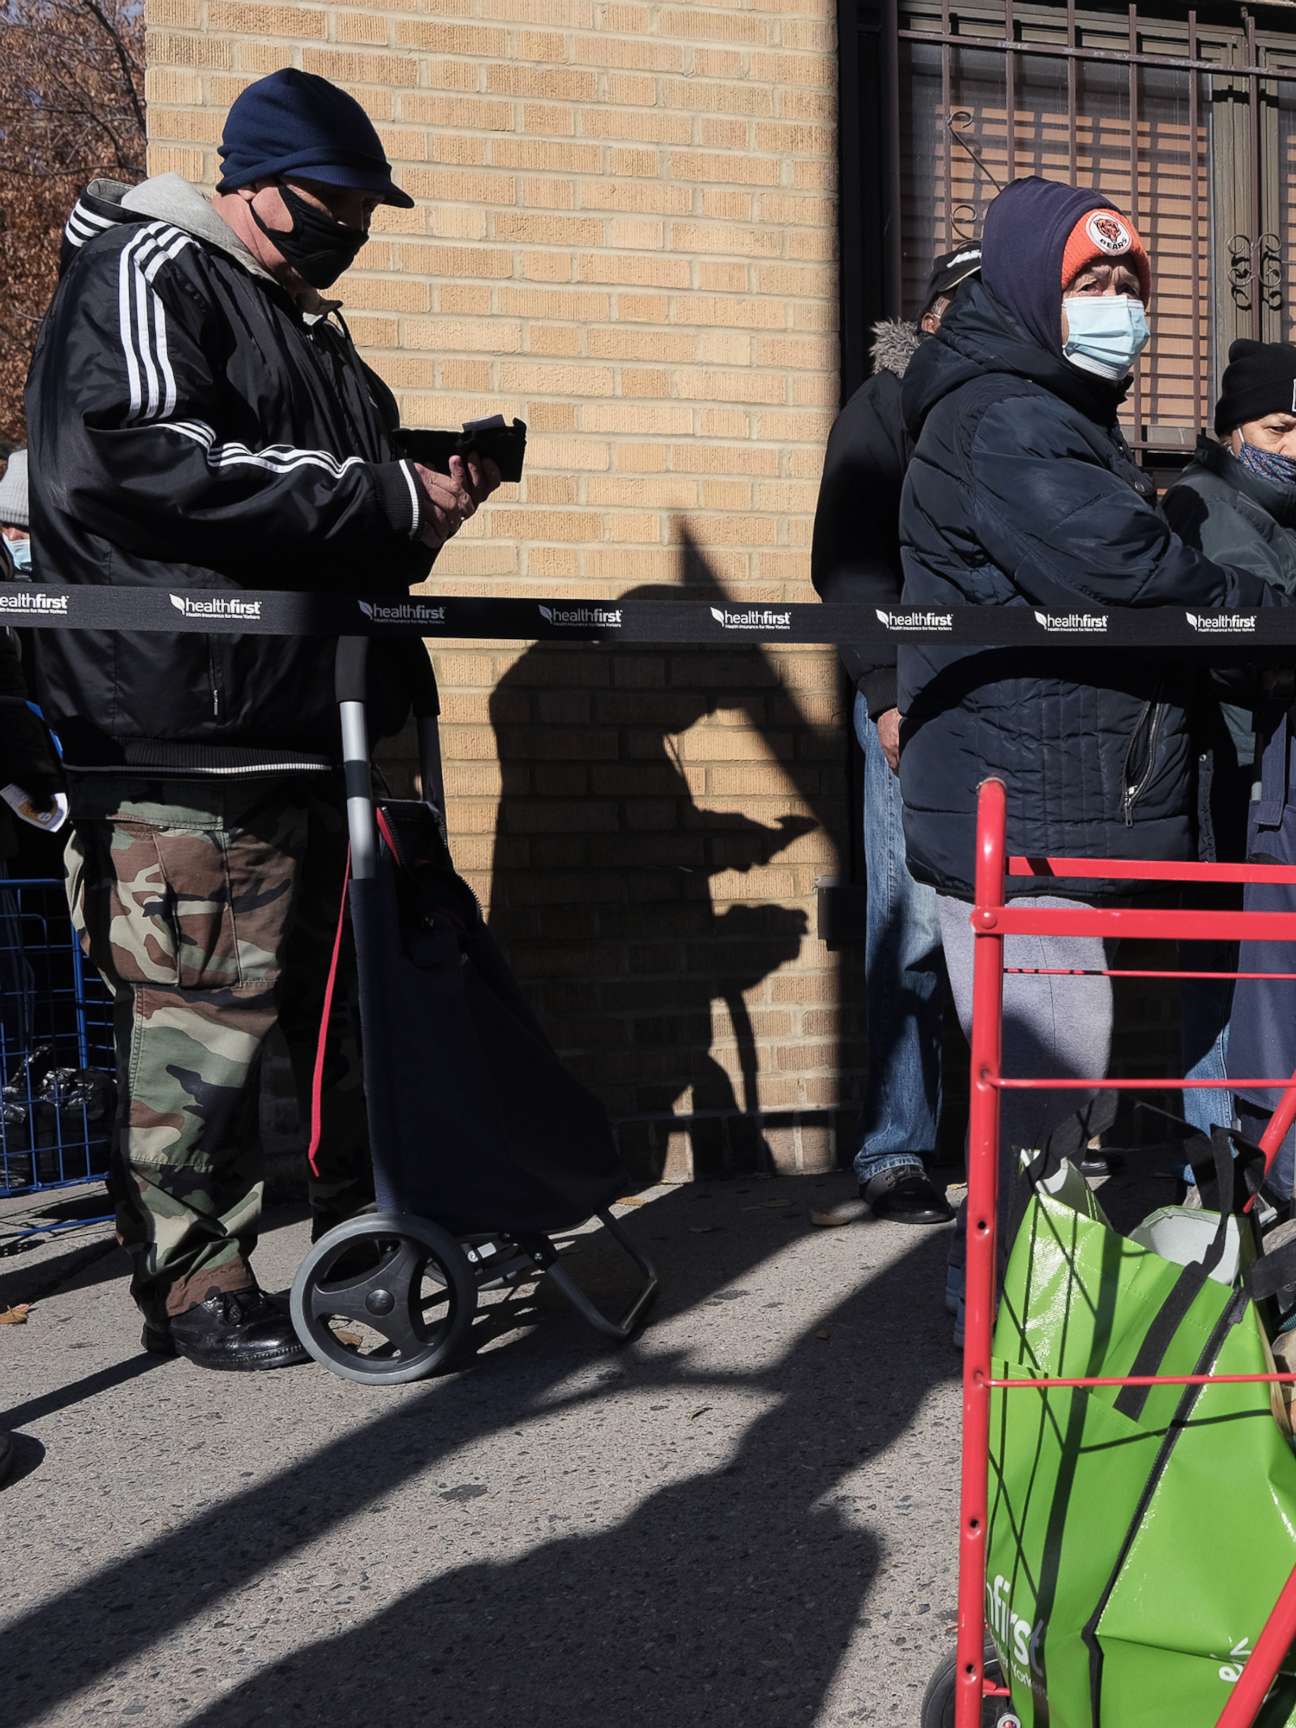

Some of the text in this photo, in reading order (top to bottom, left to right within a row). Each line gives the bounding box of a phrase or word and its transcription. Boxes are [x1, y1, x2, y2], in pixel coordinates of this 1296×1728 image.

[1100, 238, 1127, 250] BEARS
[0, 593, 67, 609] ealthfirst
[186, 597, 261, 614] healthfirst
[374, 603, 445, 619] healthfirst
[553, 608, 621, 622] healthfirst
[725, 610, 790, 624] healthfirst
[889, 611, 952, 626] healthfirst
[1048, 614, 1107, 627] healthfirst
[1198, 614, 1255, 627] healthfirst
